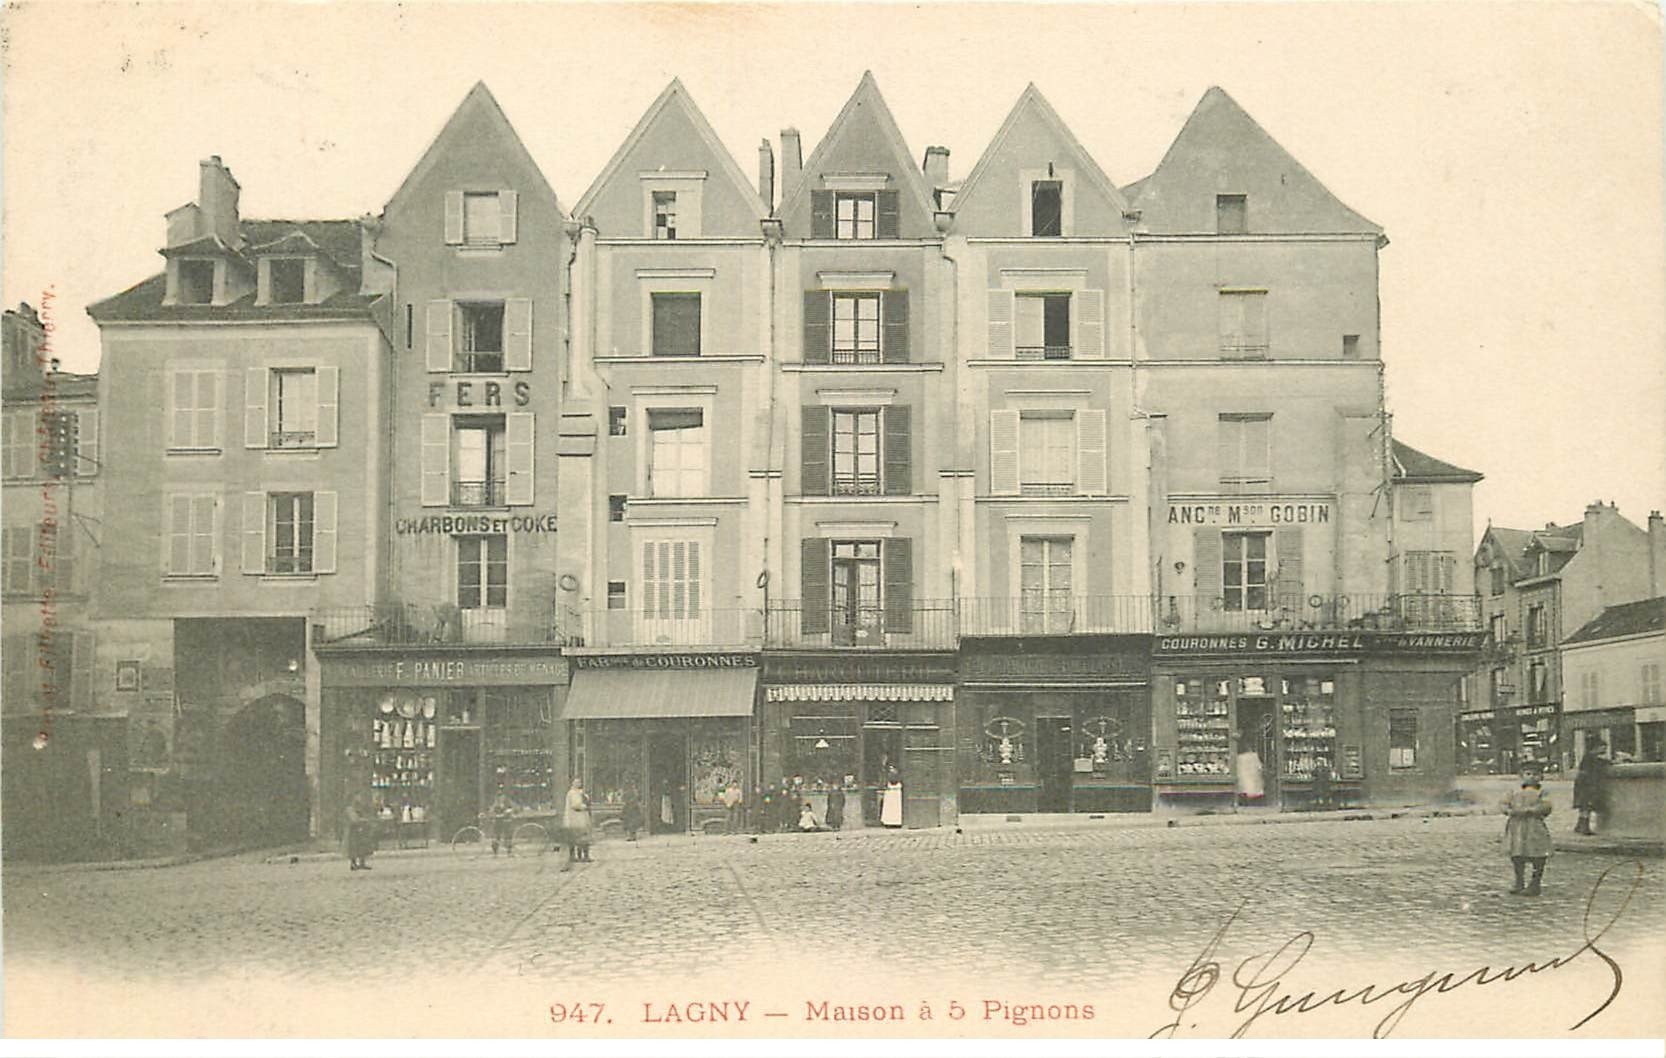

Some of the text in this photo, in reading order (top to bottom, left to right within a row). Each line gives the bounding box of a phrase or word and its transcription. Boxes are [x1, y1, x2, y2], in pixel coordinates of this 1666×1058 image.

[429, 381, 531, 407] FERS
[1270, 504, 1329, 524] GOBIN
[395, 514, 558, 535] CHARBONS ET COKE
[1161, 637, 1248, 651] COURONNES
[1256, 636, 1276, 650] G.
[1278, 635, 1364, 650] MICHEL
[1408, 635, 1479, 648] VANNERIE
[414, 661, 465, 680] PANIER
[645, 654, 757, 668] COURONNES
